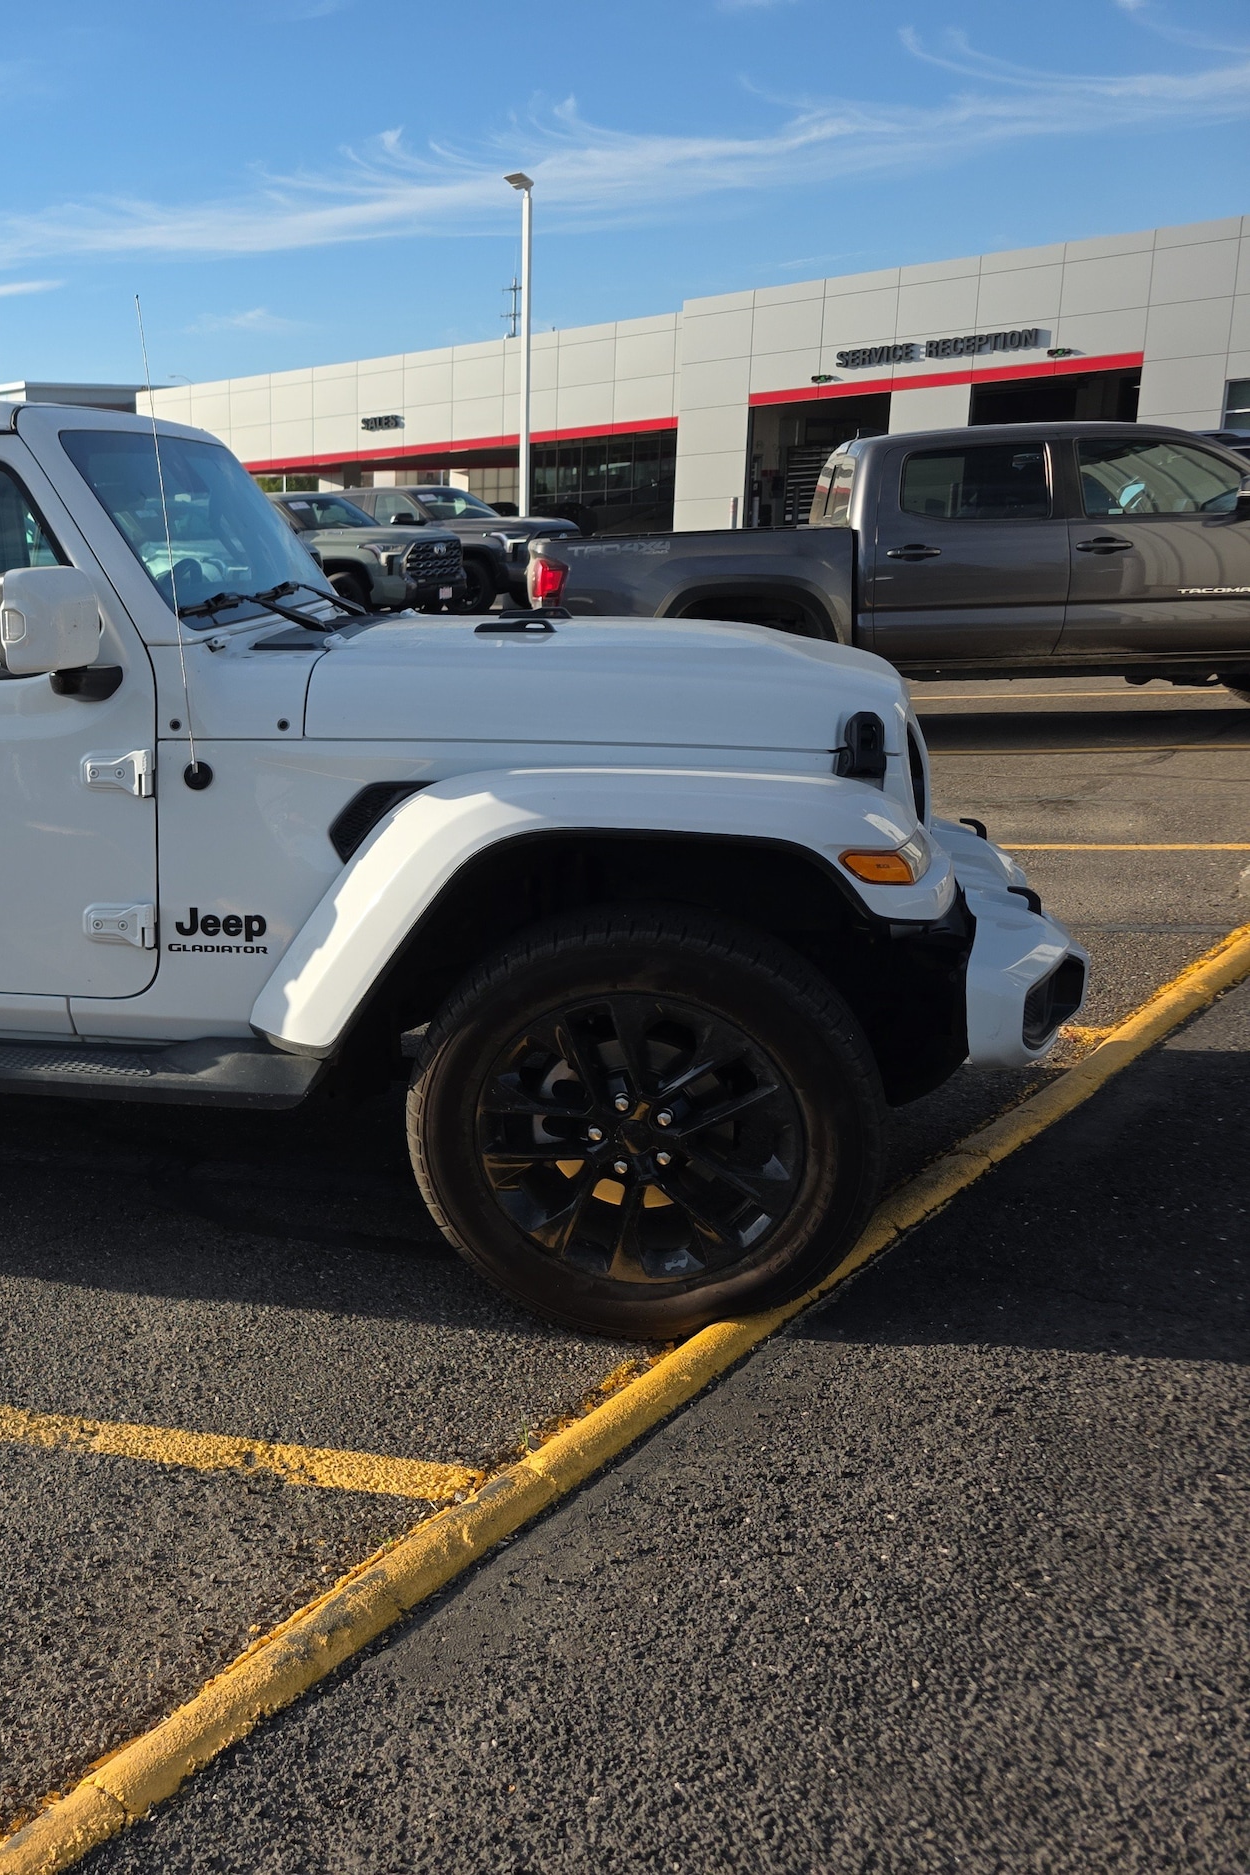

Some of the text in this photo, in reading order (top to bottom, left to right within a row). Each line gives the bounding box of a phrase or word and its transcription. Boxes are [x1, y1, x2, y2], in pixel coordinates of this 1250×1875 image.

[836, 328, 1040, 368] SERVICE RECEPTION
[361, 415, 398, 431] SALES
[175, 907, 267, 942] Jeep
[168, 943, 269, 954] GLADIATOR
